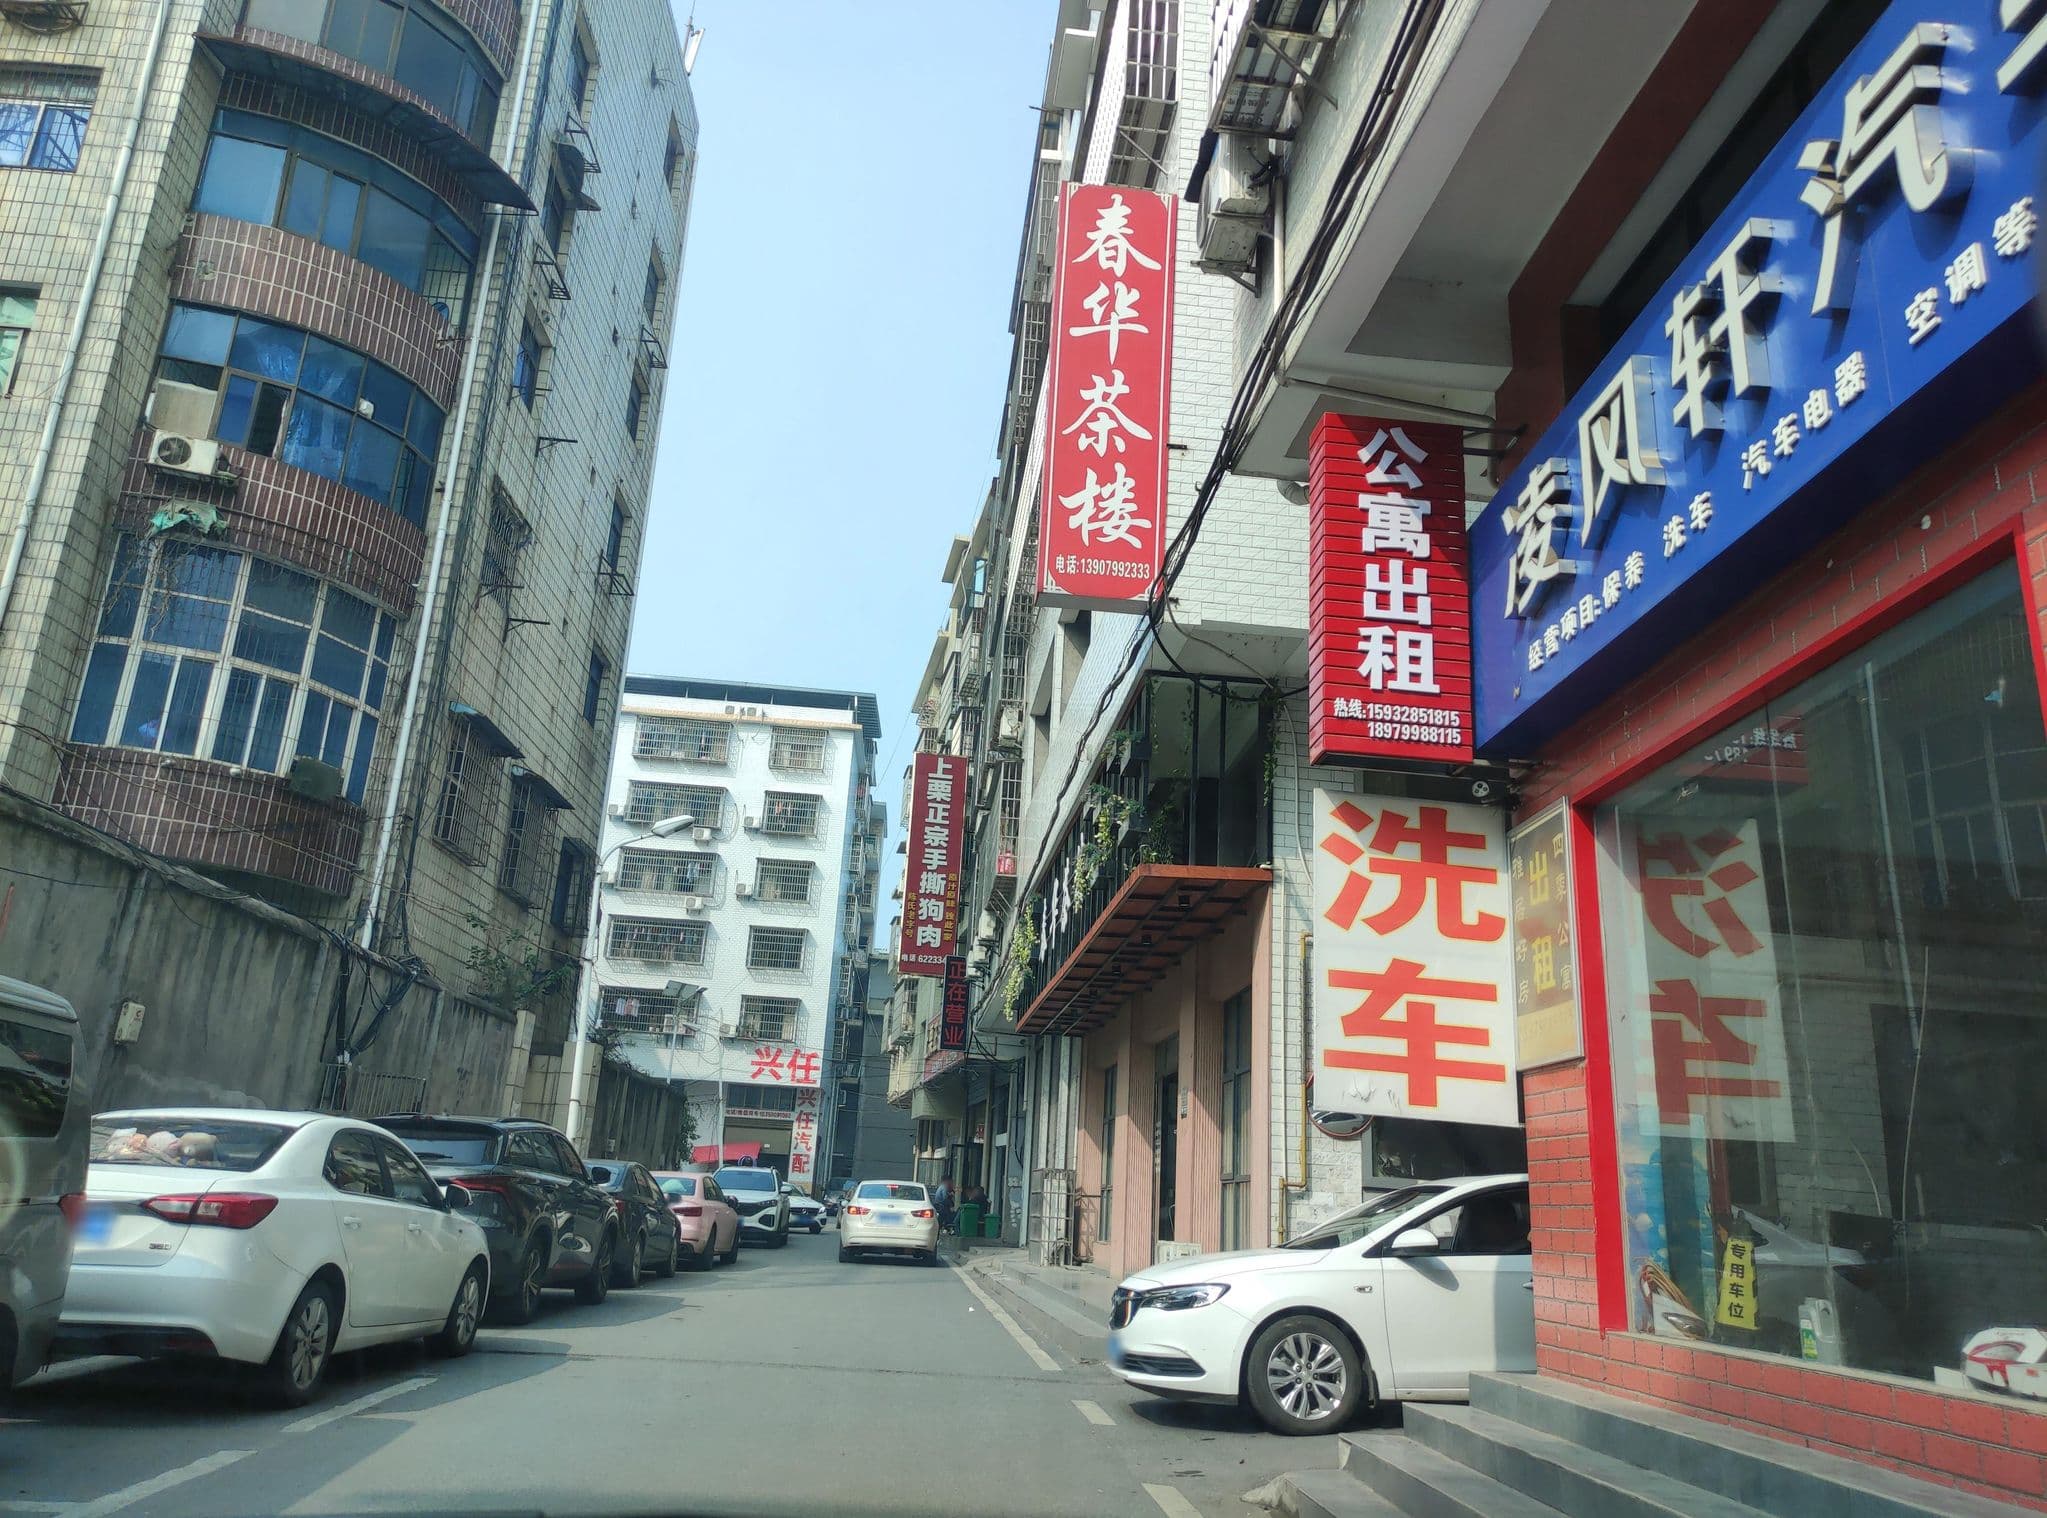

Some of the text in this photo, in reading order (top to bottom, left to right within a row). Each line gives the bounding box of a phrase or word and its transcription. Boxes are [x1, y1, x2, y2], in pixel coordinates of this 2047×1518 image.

[1058, 193, 1162, 549] 春华茶楼
[1357, 427, 1441, 695] 公寓出租
[1367, 721, 1461, 745] 18979988115
[917, 757, 953, 948] 上栗正宗手撕狗肉
[1320, 800, 1506, 1108] 洗车
[1528, 850, 1557, 995] 出租
[944, 960, 967, 1046] 正在营业
[751, 1046, 820, 1084] 兴任
[791, 1088, 817, 1174] 兴任汽配
[1728, 1243, 1746, 1319] 专用车位
